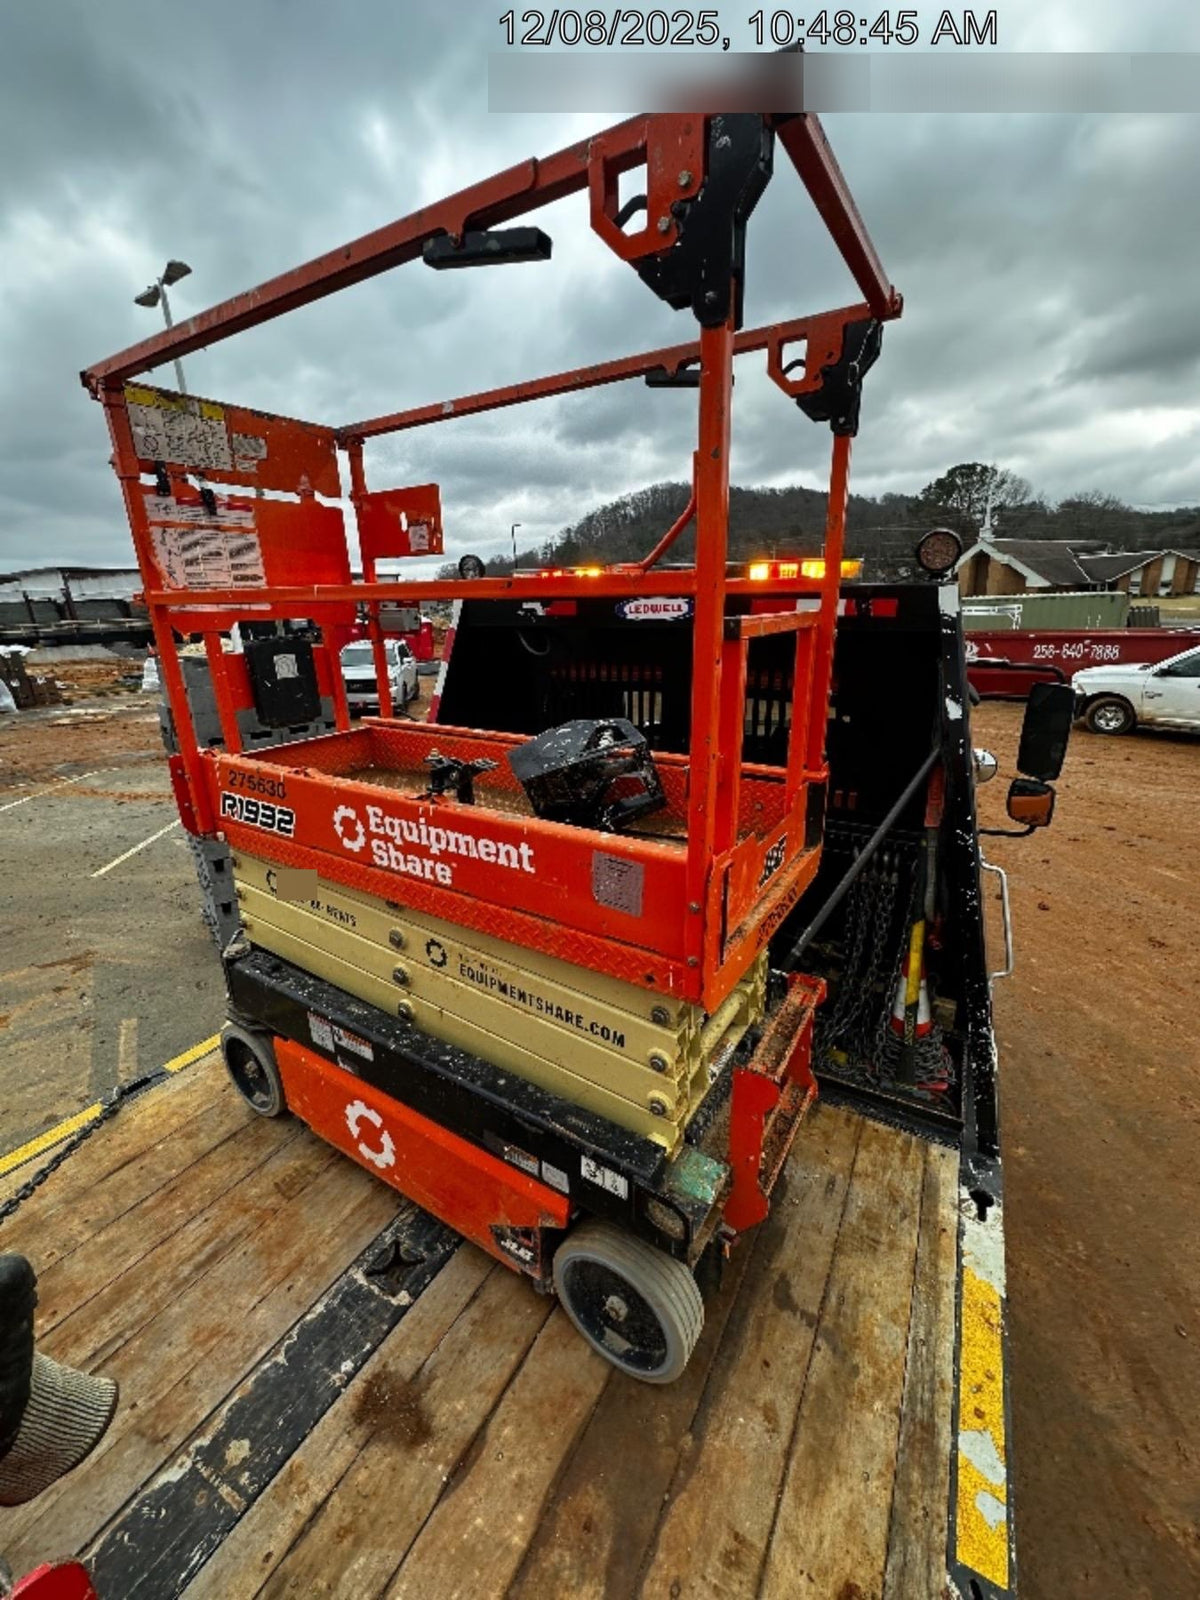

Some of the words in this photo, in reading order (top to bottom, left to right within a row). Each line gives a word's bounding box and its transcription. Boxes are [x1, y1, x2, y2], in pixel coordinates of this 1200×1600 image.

[628, 602, 684, 616] LEDWELL
[228, 769, 286, 799] 275630
[221, 791, 296, 838] R1932
[366, 804, 536, 873] Equipment
[371, 839, 452, 884] Share
[459, 962, 626, 1048] EQUIPMENTSHARE.COM
